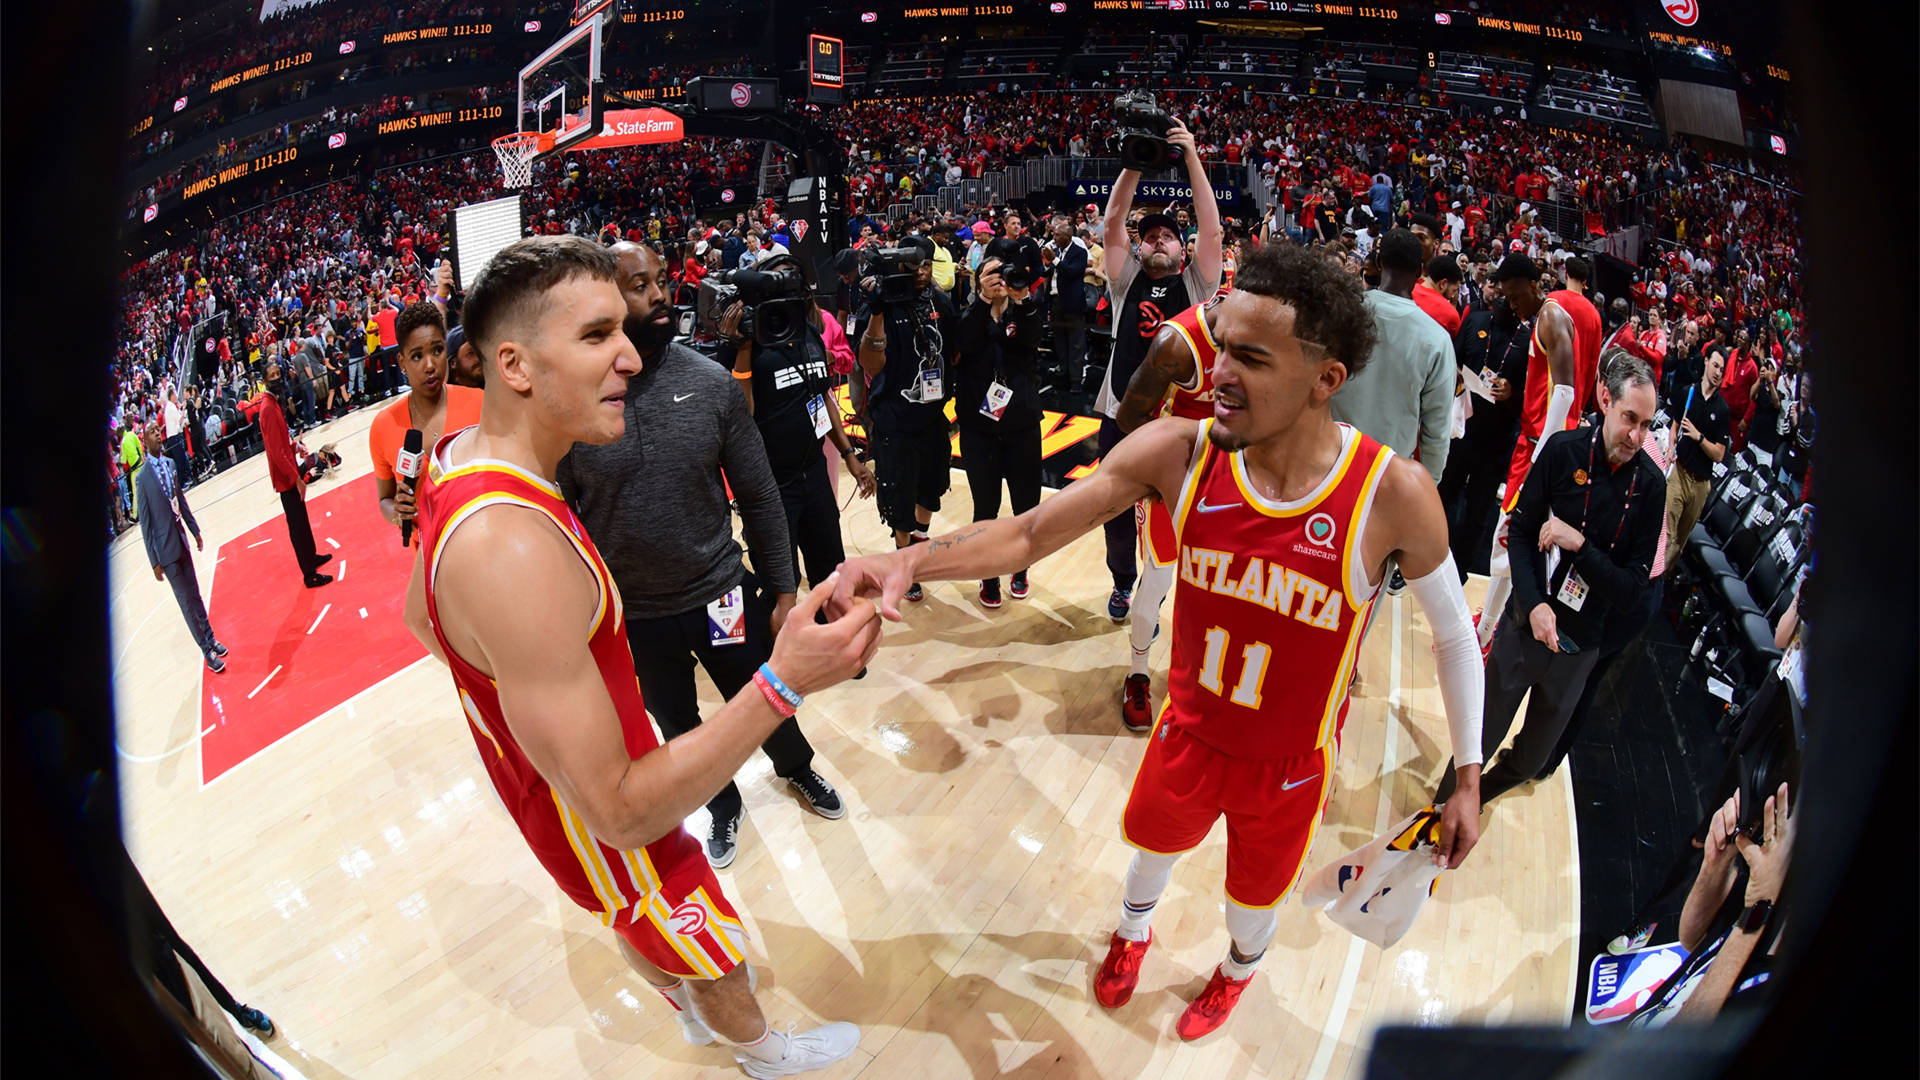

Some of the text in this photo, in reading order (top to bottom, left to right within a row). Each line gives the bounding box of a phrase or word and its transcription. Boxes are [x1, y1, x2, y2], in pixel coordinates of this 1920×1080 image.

[642, 10, 684, 22] 111-110
[904, 6, 1012, 18] HAWKS WIN!!! 111-110
[1094, 0, 1128, 10] HAWKS
[1188, 1, 1205, 9] 111
[1270, 2, 1288, 11] 110
[1323, 6, 1353, 16] WIN!!!
[1359, 8, 1398, 19] 111-110
[383, 24, 492, 45] HAWKS WIN!!! 111-110
[1477, 16, 1582, 42] HAWKS WIN!!! 111-110
[210, 52, 312, 94] HAWKS WIN!!! 111-110
[378, 106, 502, 136] HAWKS WIN!!! 111-110
[183, 147, 297, 200] HAWKS WIN!!! 111-110
[818, 176, 828, 243] NBA TV
[1292, 543, 1337, 561] sharecare
[1180, 544, 1344, 632] ATLANTA
[1198, 624, 1273, 711] 11
[1597, 962, 1618, 997] NBA
